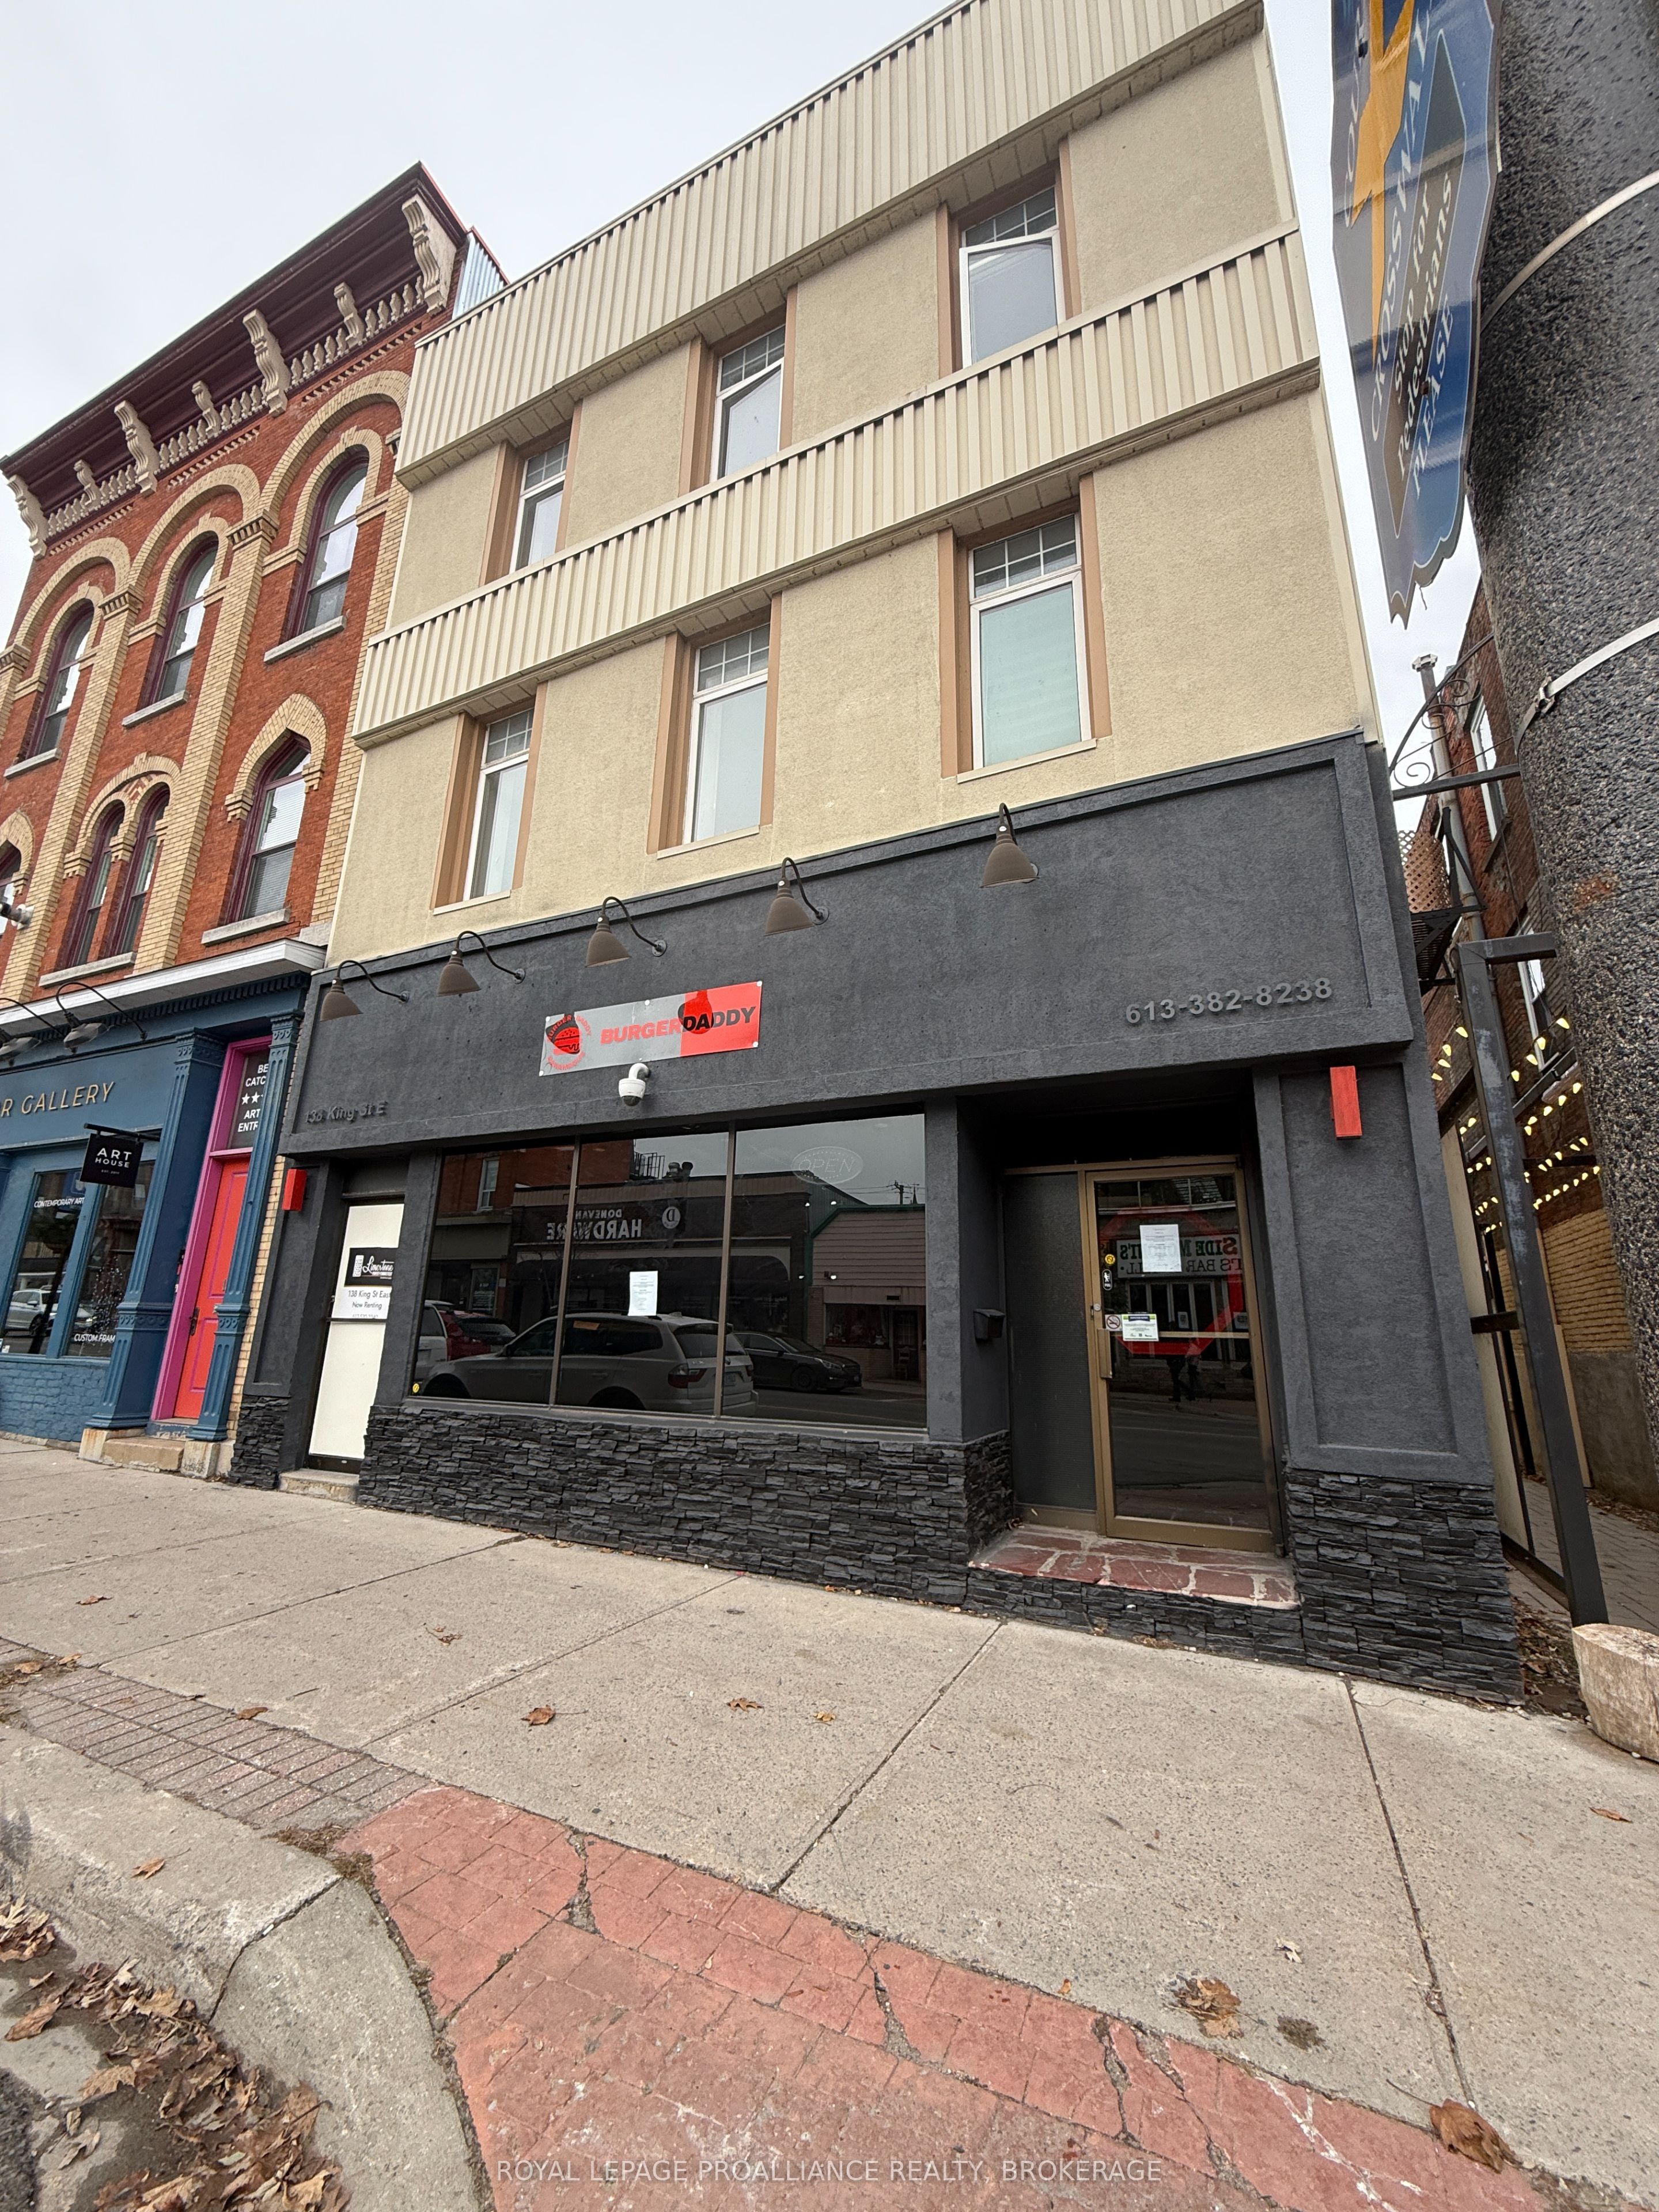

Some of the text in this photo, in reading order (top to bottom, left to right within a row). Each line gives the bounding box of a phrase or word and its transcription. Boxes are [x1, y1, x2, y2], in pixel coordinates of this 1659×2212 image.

[1371, 0, 1433, 442] CROSSWAL
[1412, 180, 1430, 283] for
[1413, 293, 1454, 500] PLEASE
[1126, 977, 1332, 1024] 613-382-8238
[21, 1081, 115, 1114] GALLERY
[327, 1105, 355, 1121] King
[358, 1103, 373, 1116] St
[375, 1100, 388, 1115] E
[95, 1157, 130, 1168] HOUSE
[97, 1147, 132, 1161] ART
[798, 1157, 854, 1175] OPEN
[33, 1197, 85, 1209] CONTEMPORARY ART
[358, 1290, 371, 1299] King
[363, 1301, 382, 1310] Renting
[74, 1334, 98, 1342] CUSTOM
